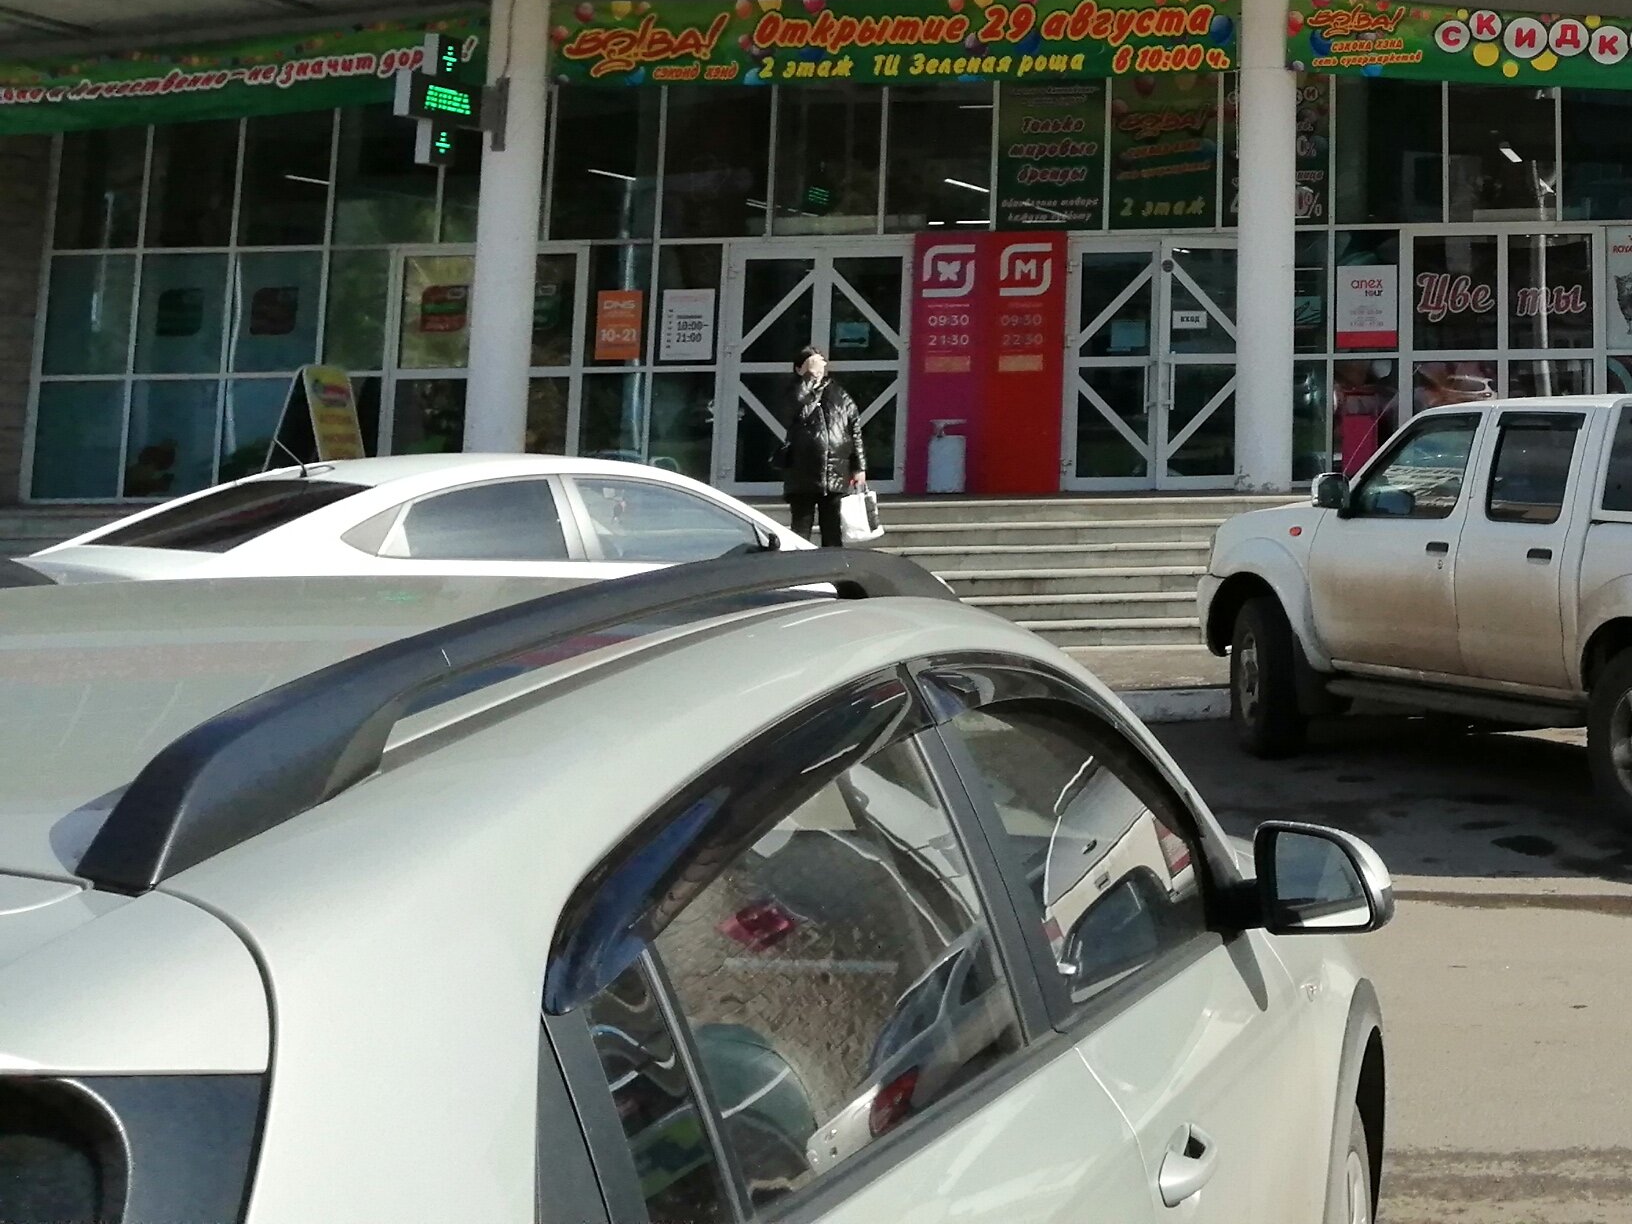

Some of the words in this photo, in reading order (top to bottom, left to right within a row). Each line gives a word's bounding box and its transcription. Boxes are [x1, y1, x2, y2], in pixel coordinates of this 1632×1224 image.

[753, 9, 971, 54] Открытие
[977, 2, 1037, 43] 29
[758, 53, 776, 79] 2
[782, 53, 854, 78] этаж
[873, 52, 901, 77] ТЦ
[909, 52, 1010, 75] Зеленая
[1016, 52, 1086, 77] роща
[1135, 43, 1203, 72] 10:00
[1351, 278, 1384, 289] anex
